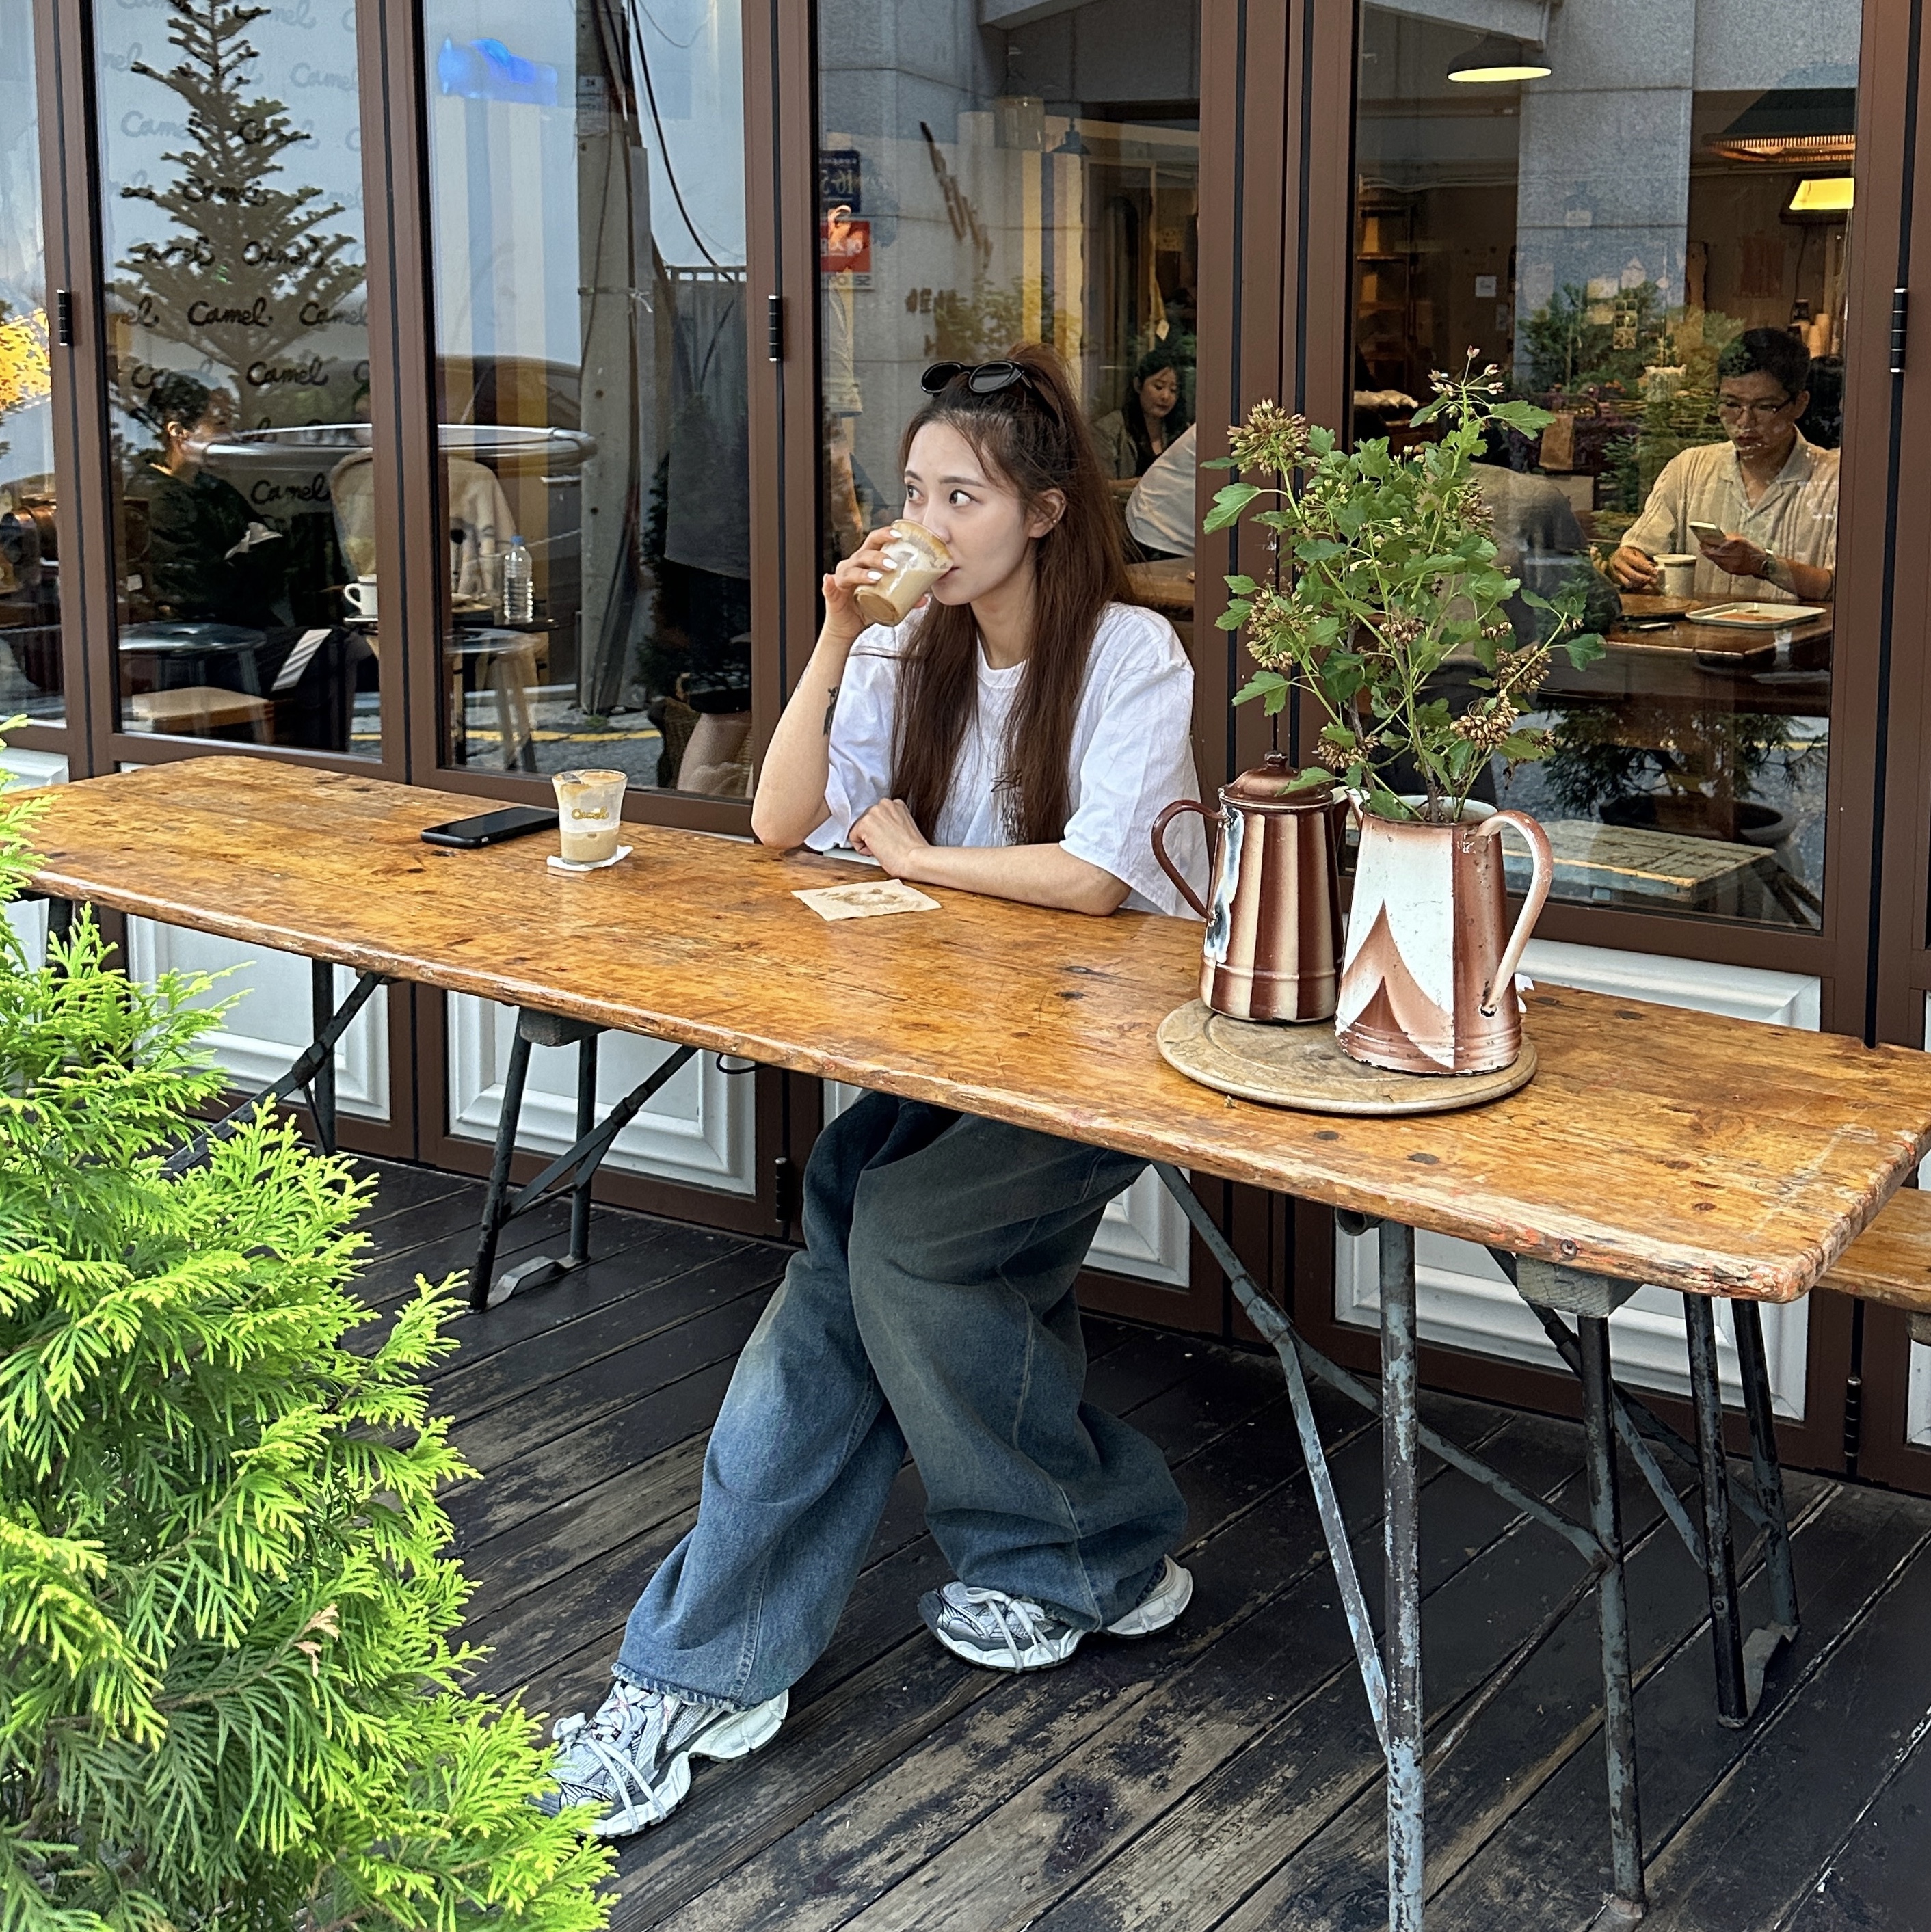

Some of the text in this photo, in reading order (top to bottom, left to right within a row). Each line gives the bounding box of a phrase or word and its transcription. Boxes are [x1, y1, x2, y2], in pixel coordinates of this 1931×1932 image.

[188, 296, 273, 327] Camel
[246, 355, 330, 387] Camel
[250, 473, 332, 505] Camel
